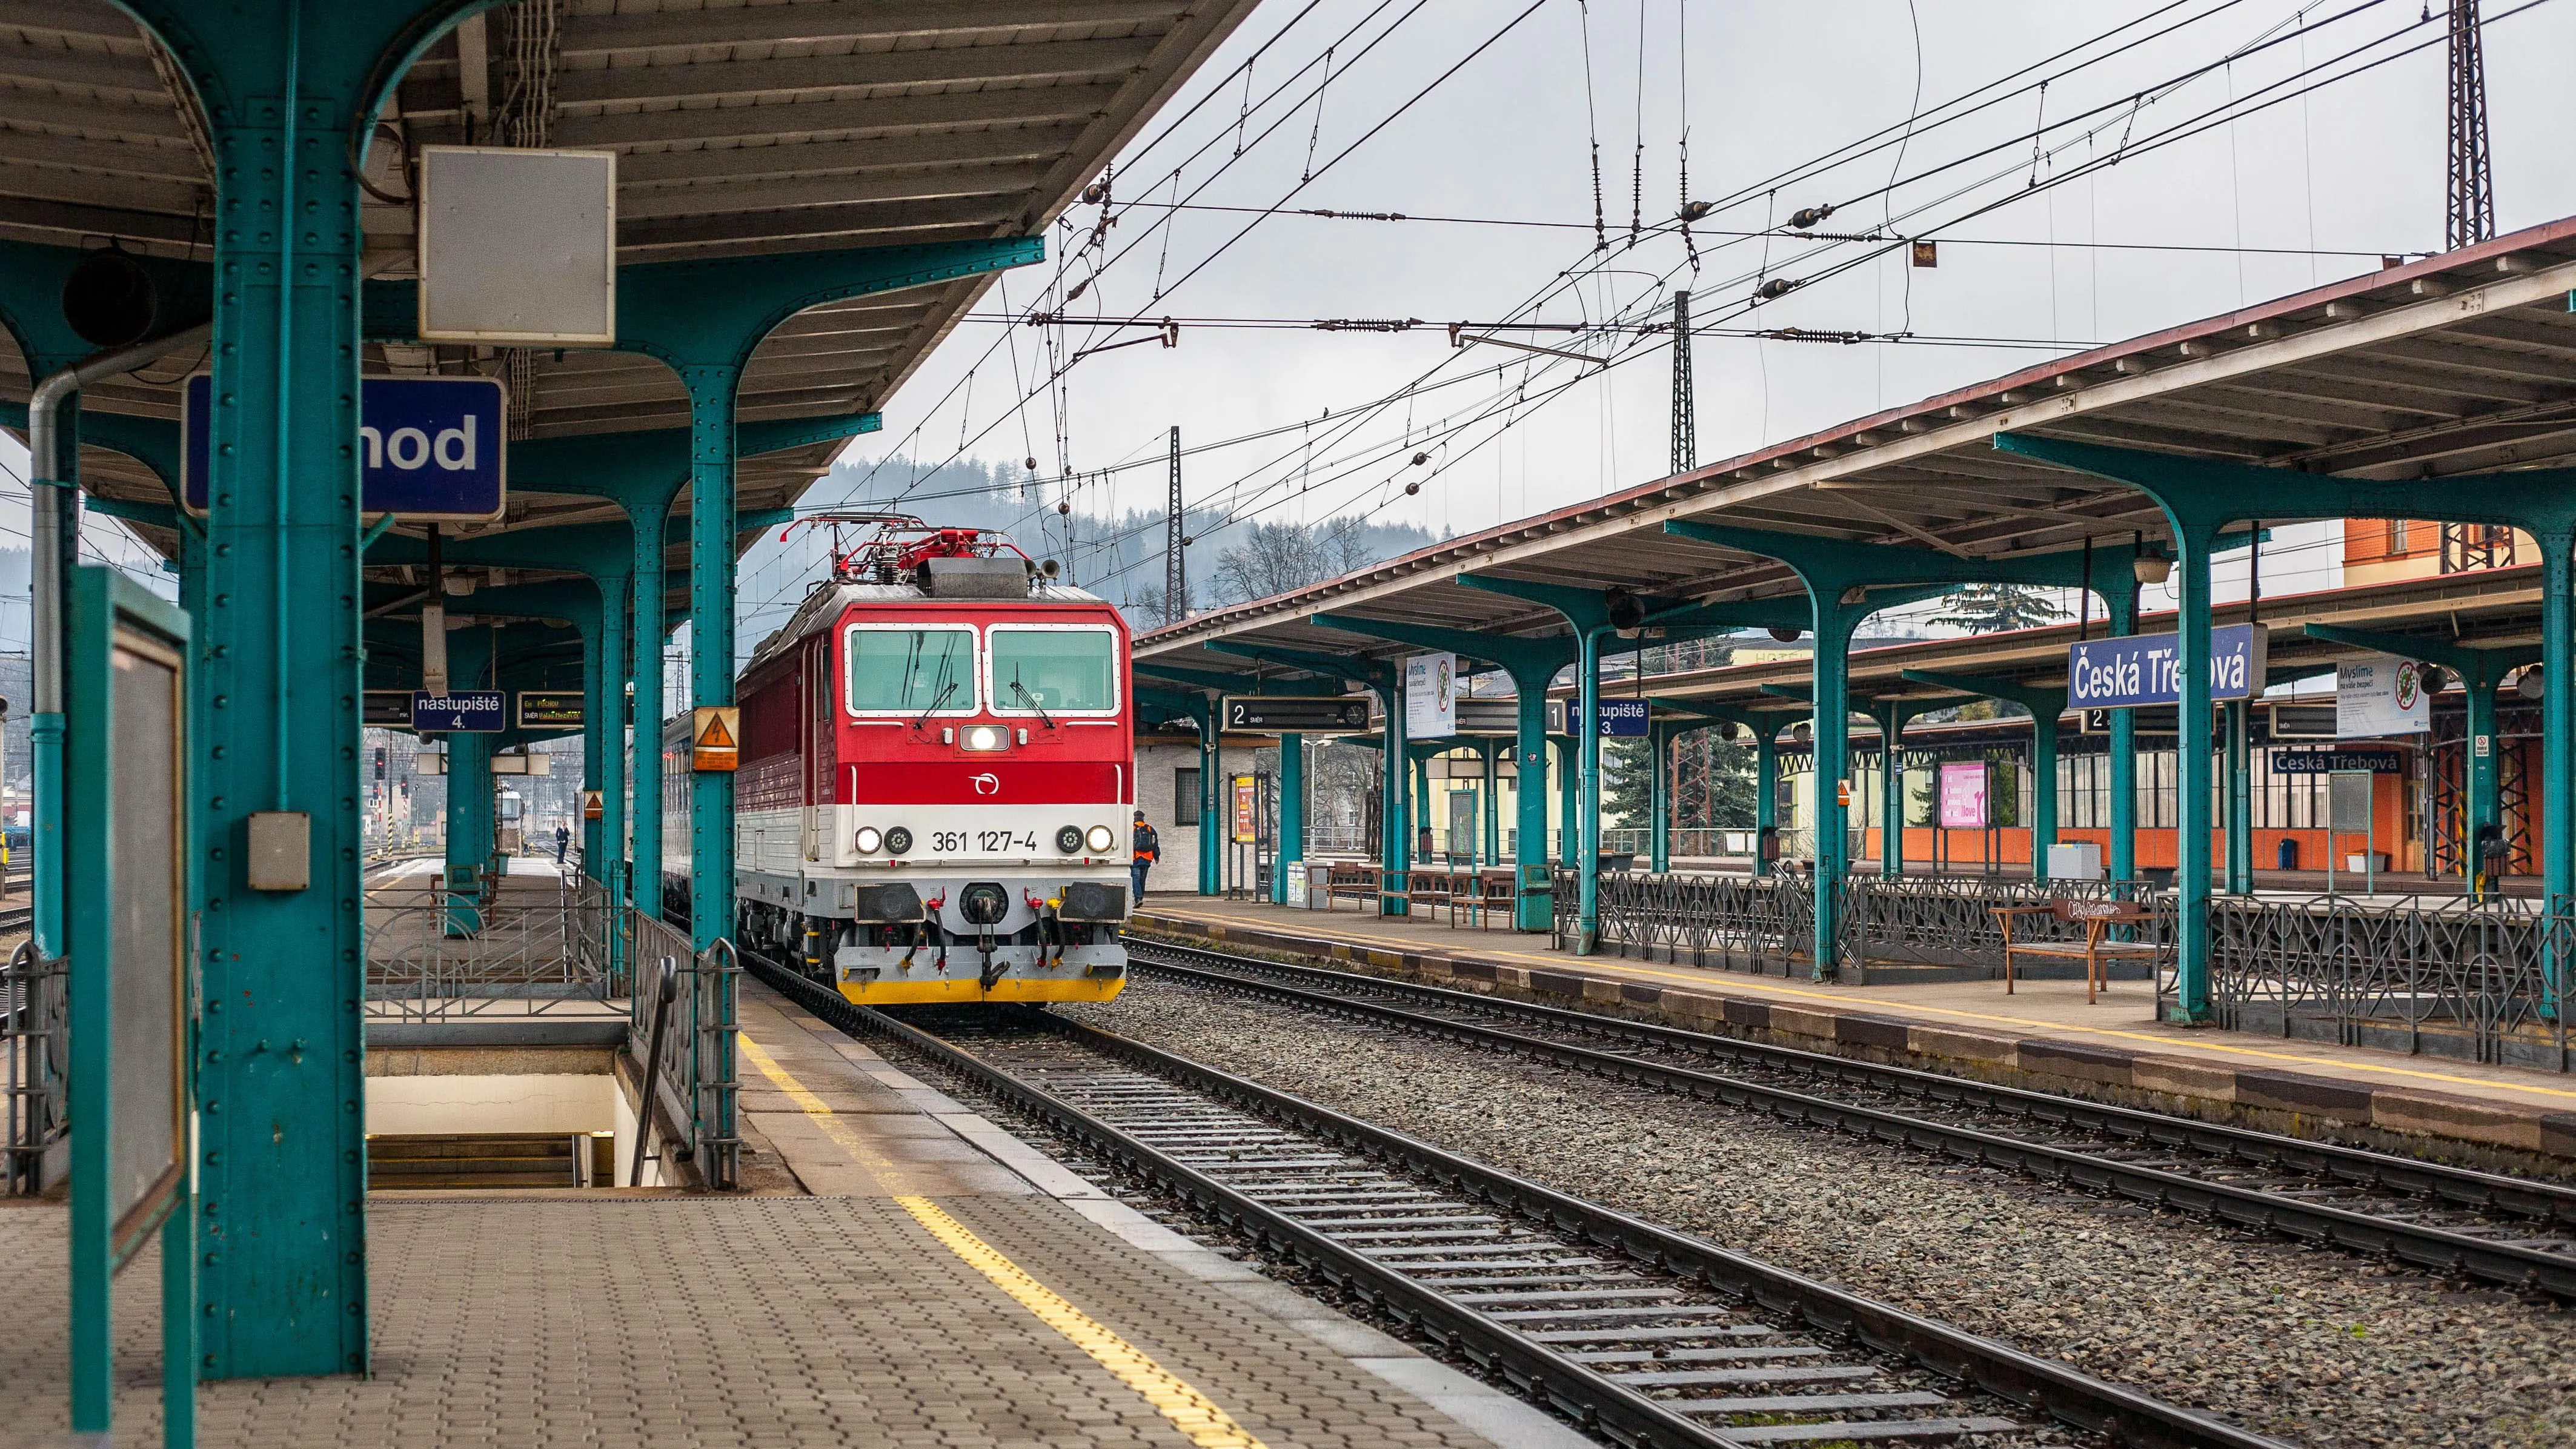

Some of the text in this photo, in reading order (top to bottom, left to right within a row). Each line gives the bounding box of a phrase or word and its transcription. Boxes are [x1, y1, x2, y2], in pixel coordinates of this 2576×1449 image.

[2075, 642, 2245, 699] Česká Třevá
[2340, 665, 2373, 681] Myslíme
[419, 697, 499, 713] nástupiště
[452, 715, 465, 729] 4.
[1234, 705, 1244, 724] 2
[1551, 708, 1558, 726] 1
[2093, 709, 2102, 726] 2
[1602, 721, 1614, 734] 3.
[2276, 753, 2397, 770] Česká Třebová
[932, 831, 1037, 852] 361 127-4
